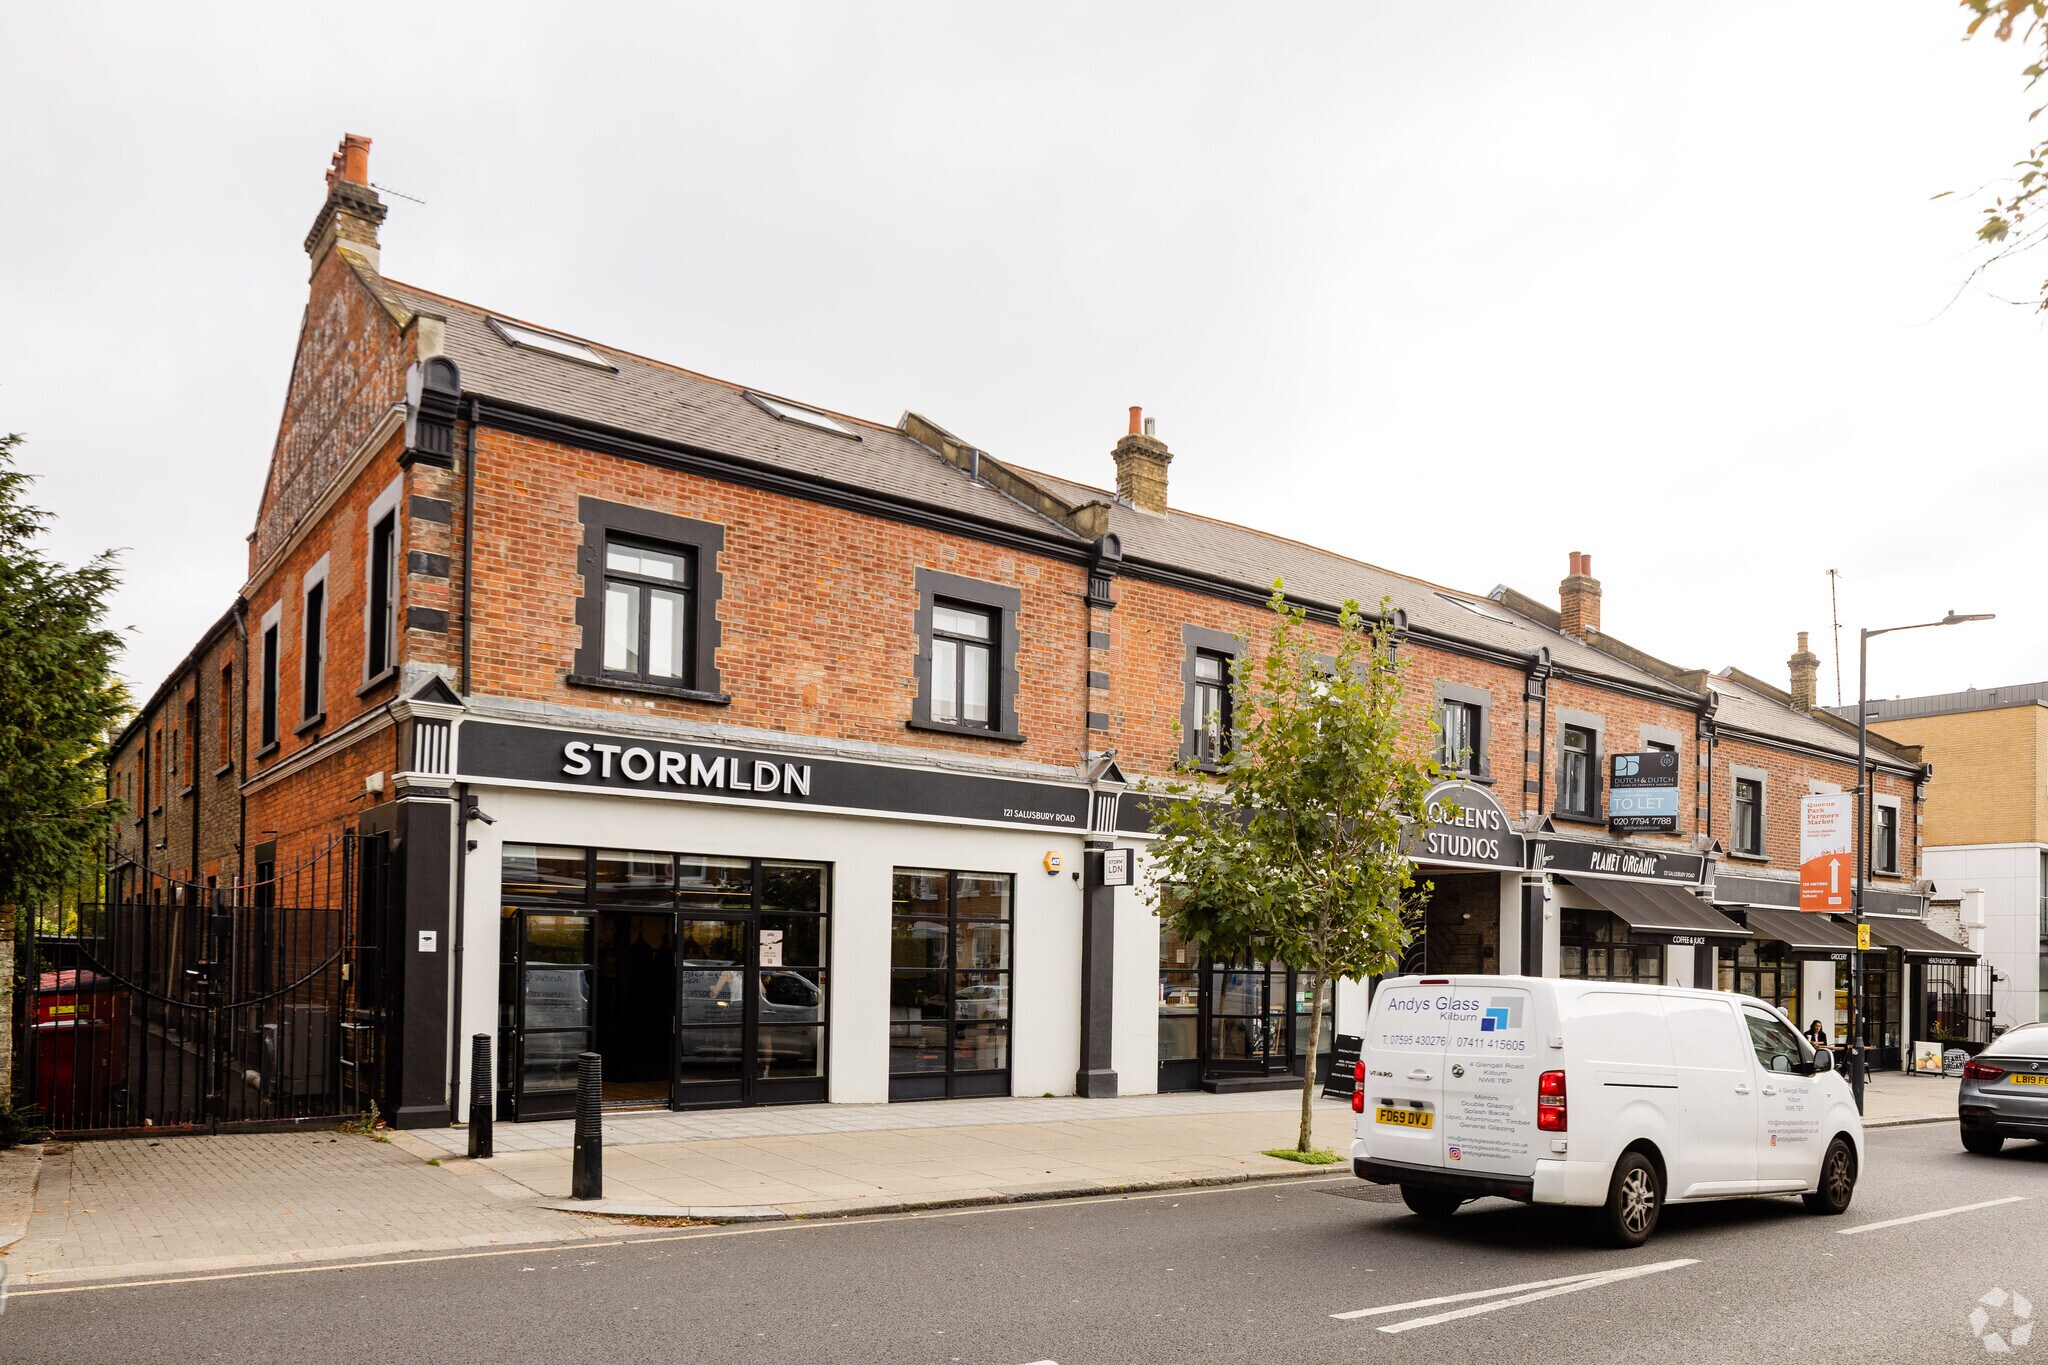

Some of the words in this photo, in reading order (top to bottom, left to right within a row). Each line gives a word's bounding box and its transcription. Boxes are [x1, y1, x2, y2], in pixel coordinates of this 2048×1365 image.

[562, 741, 811, 796] STORMLDN
[1613, 798, 1633, 810] TO
[1637, 797, 1665, 809] LET
[1003, 808, 1013, 817] 121
[1013, 809, 1055, 821] SALUSBURY
[1055, 813, 1076, 823] ROAD
[1613, 817, 1629, 825] 020
[1630, 817, 1650, 825] 7794
[1651, 817, 1672, 825] 7788
[1427, 832, 1499, 860] STUDIOS
[1590, 851, 1621, 872] PLANET
[1622, 854, 1657, 875] ORGANIC
[1108, 865, 1123, 874] LDN
[1672, 936, 1689, 944] COFFEE
[1689, 936, 1693, 944] &
[1693, 936, 1706, 945] JUICE
[1387, 997, 1430, 1014] Andys
[1435, 996, 1480, 1011] Glass
[1440, 1012, 1478, 1022] Kilburn
[1382, 1035, 1389, 1045] T:
[1390, 1035, 1414, 1045] 07595
[1415, 1036, 1447, 1047] 430276
[1456, 1037, 1485, 1048] 07411
[1487, 1040, 1525, 1051] 415605
[1944, 1054, 1966, 1062] PLANET
[1944, 1061, 1965, 1070] ORGAN
[1369, 1070, 1393, 1078] VIVARO
[2015, 1075, 2036, 1084] LB19
[1461, 1100, 1485, 1108] Double
[1486, 1102, 1514, 1110] Glazing
[1380, 1109, 1406, 1124] FD69
[1407, 1111, 1429, 1126] DVJ
[1464, 1108, 1487, 1116] Splash
[1488, 1109, 1510, 1117] Backs
[1505, 1118, 1531, 1126] Timber
[1487, 1124, 1515, 1133] Glazing
[1462, 1149, 1511, 1160] andysglasskilburn
